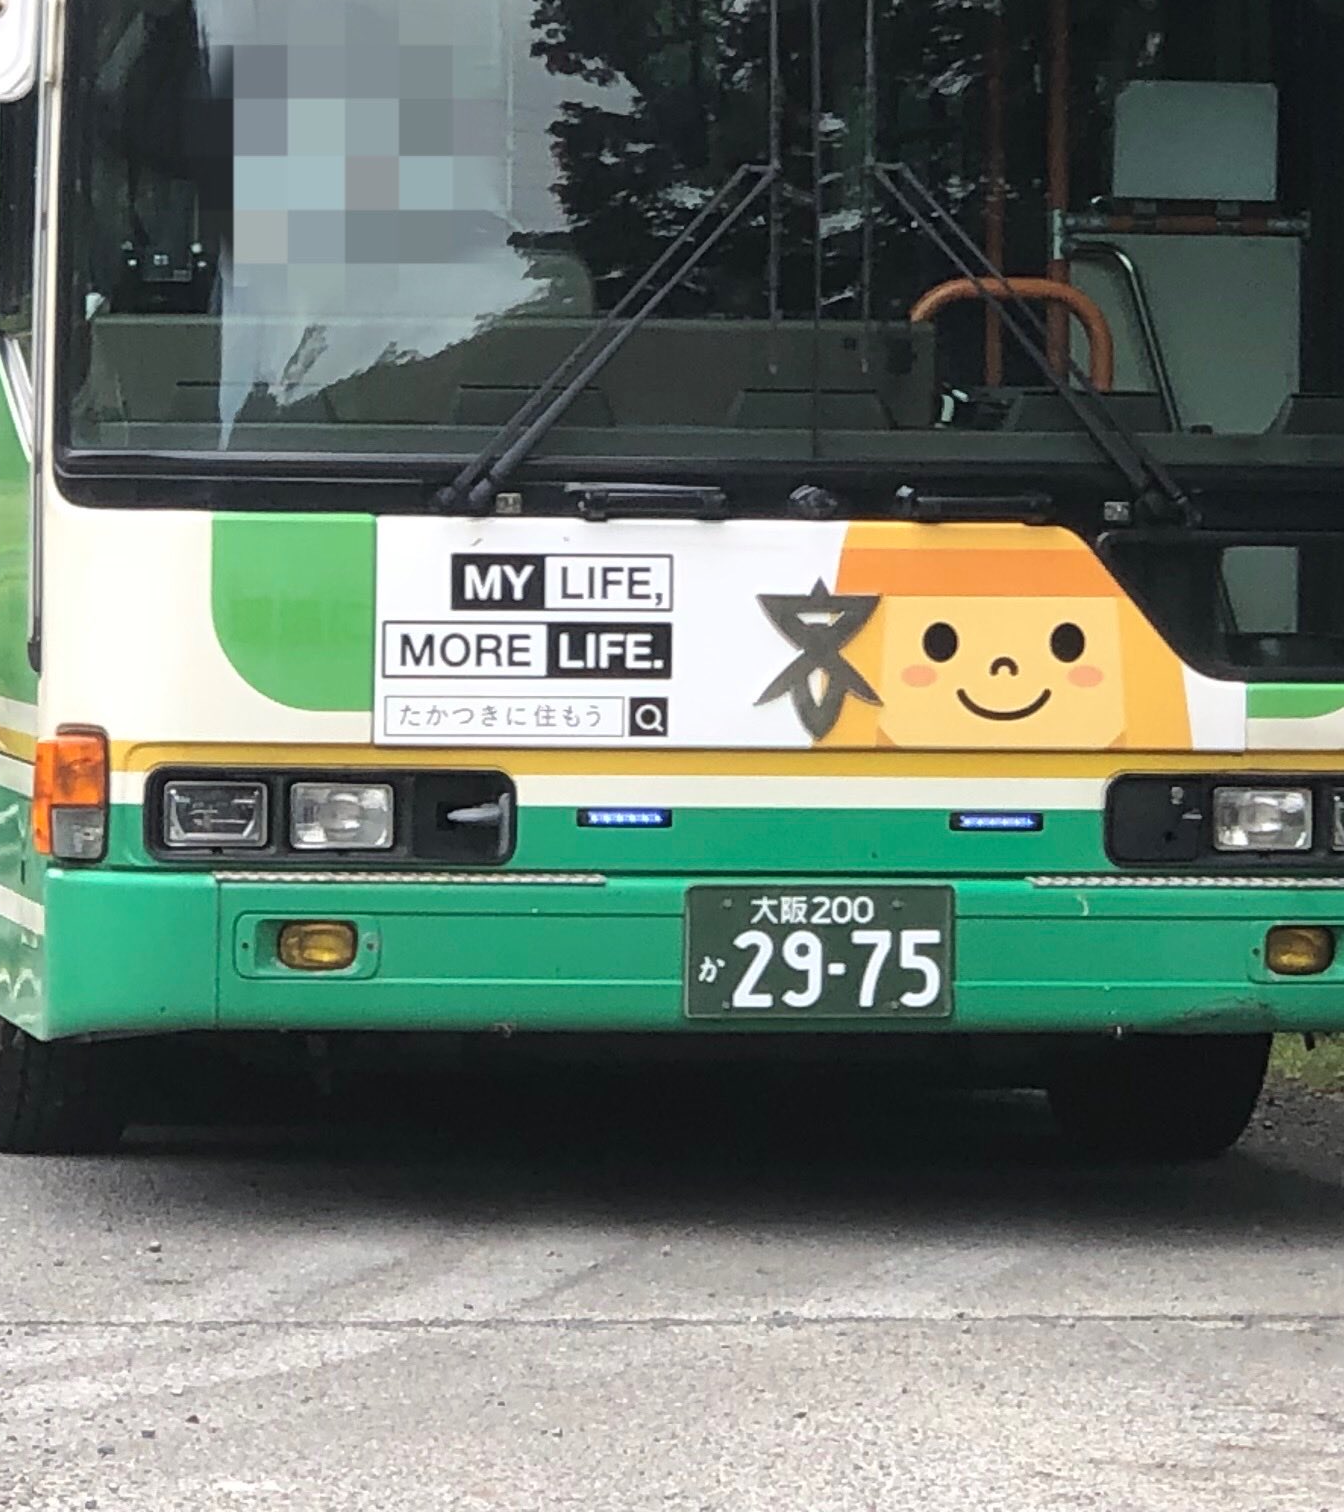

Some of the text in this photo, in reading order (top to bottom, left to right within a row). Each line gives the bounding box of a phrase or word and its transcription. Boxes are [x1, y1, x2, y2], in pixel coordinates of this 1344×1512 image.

[463, 564, 664, 606] MY LIFE,
[399, 632, 664, 670] MORE LIFE.
[399, 704, 602, 728] たかつきに住もう
[698, 930, 941, 1007] か 29-75
